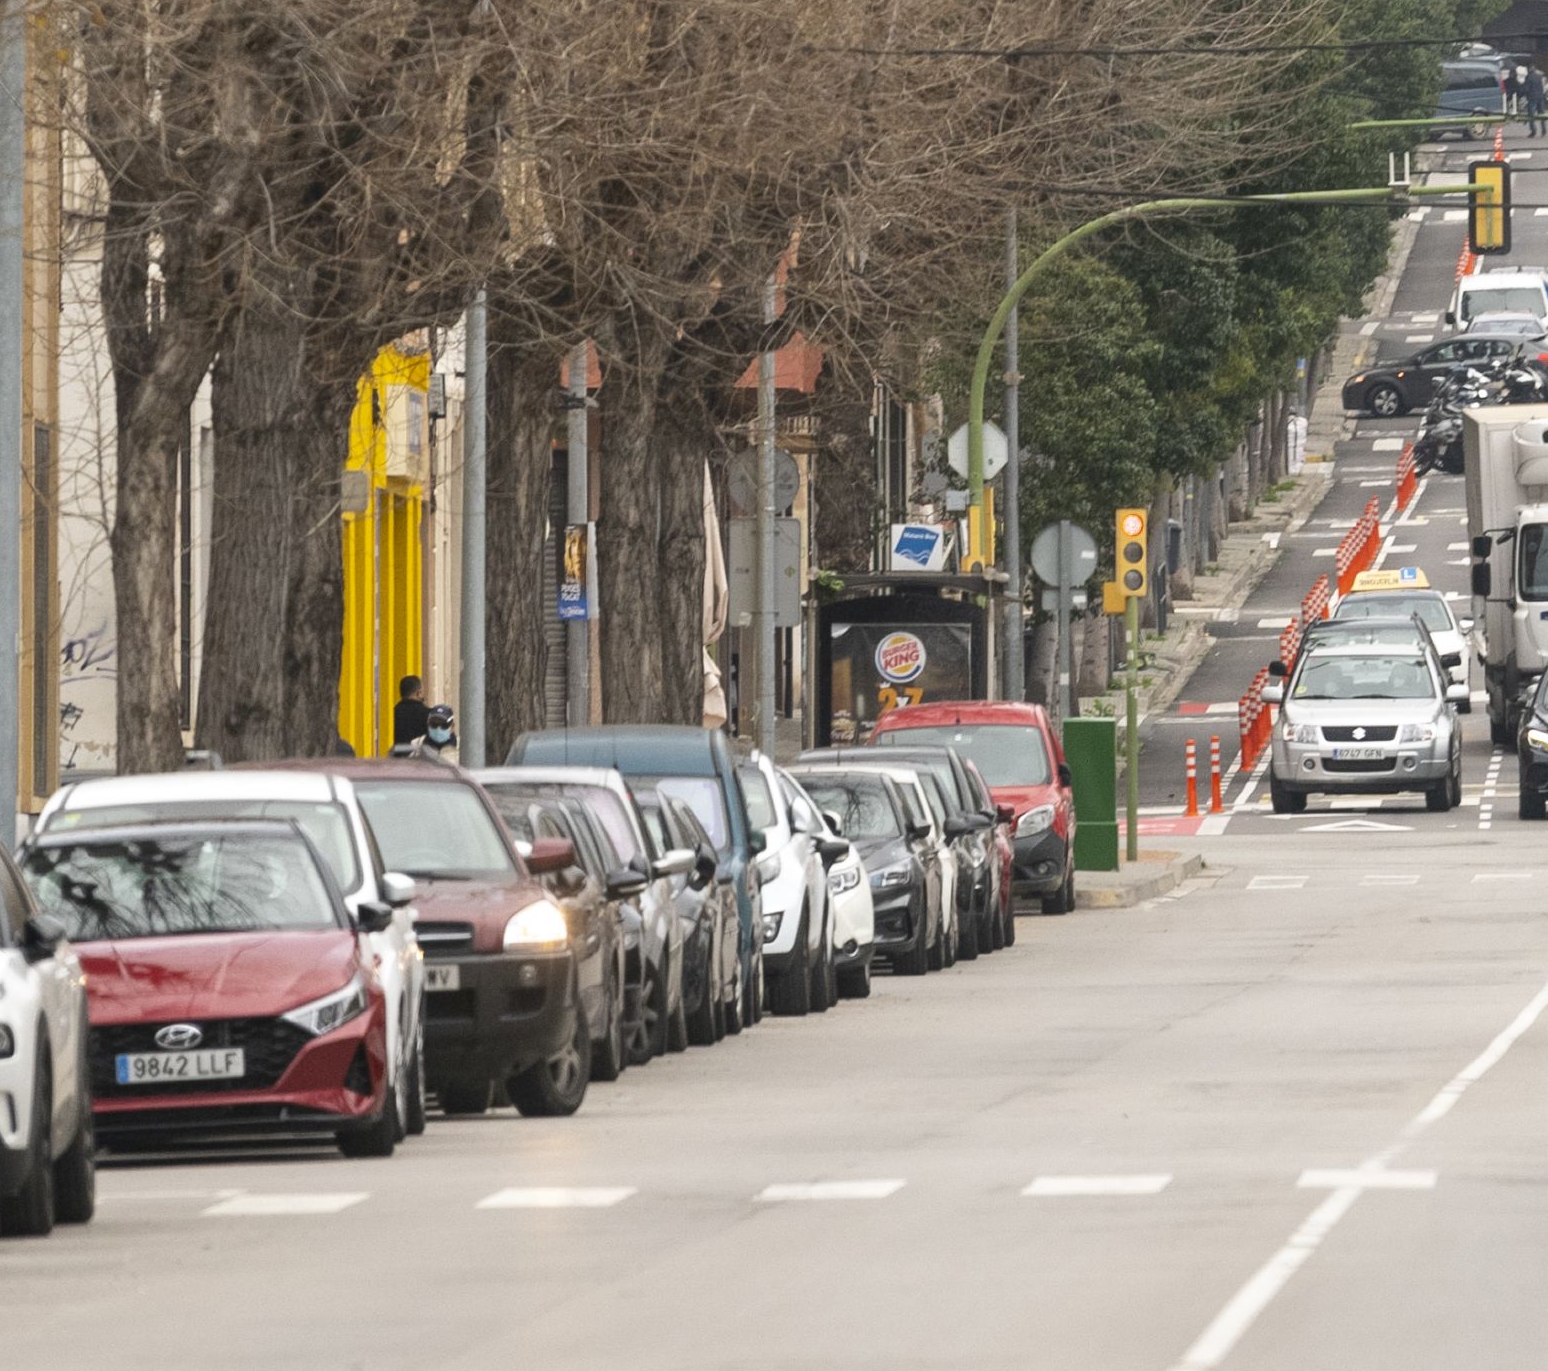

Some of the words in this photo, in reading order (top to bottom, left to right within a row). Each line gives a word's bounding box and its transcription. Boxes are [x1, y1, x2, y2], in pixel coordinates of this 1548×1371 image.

[882, 641, 918, 658] BURGER
[883, 651, 920, 670] KING
[133, 1055, 189, 1078] 9842
[196, 1052, 237, 1075] LLF
